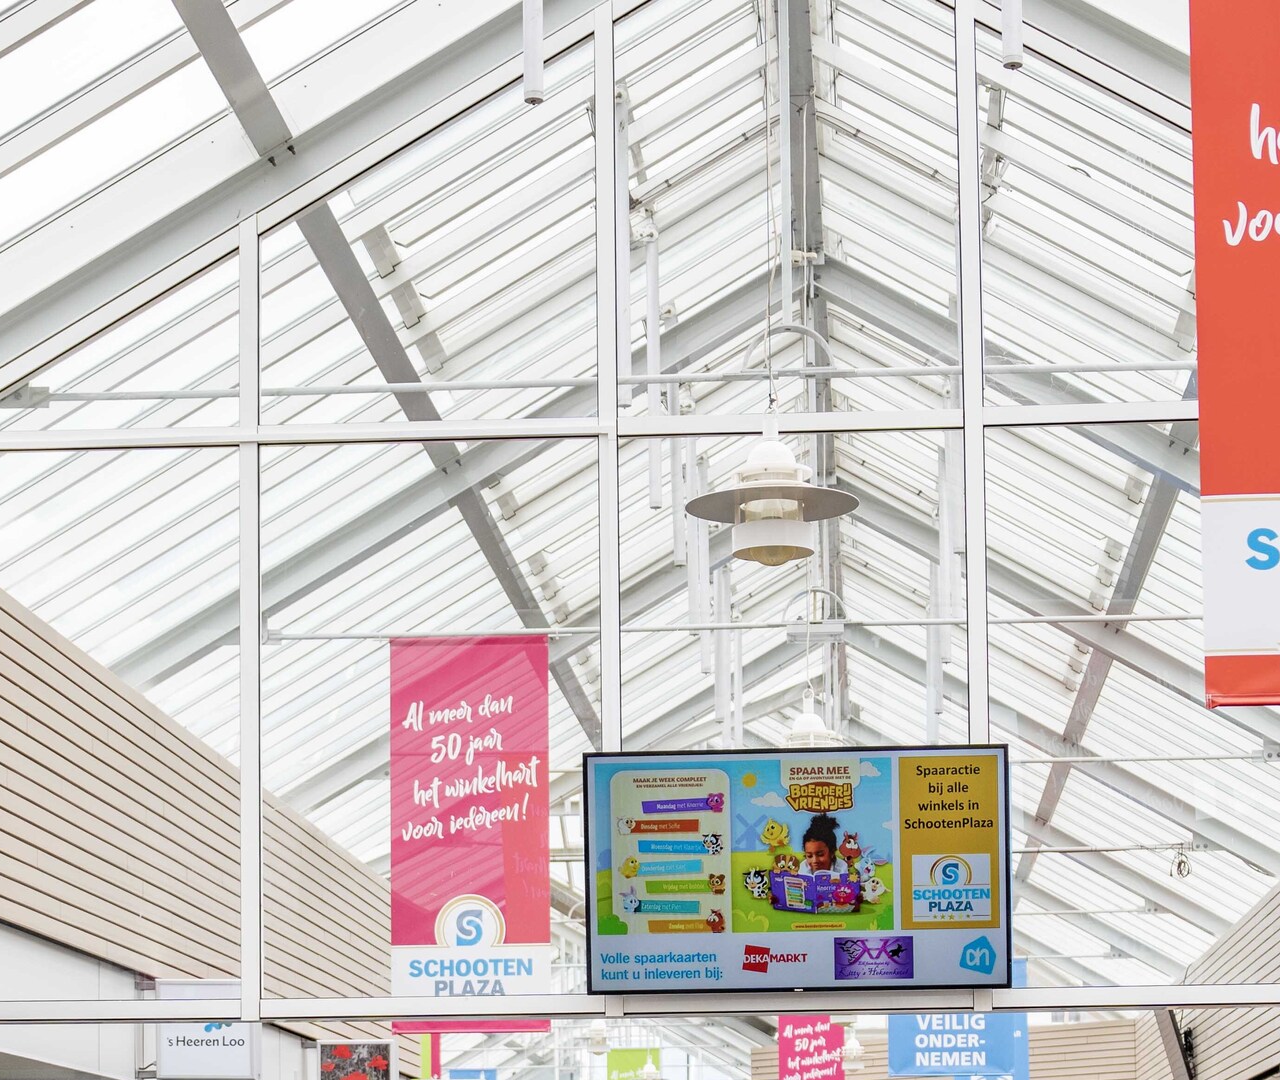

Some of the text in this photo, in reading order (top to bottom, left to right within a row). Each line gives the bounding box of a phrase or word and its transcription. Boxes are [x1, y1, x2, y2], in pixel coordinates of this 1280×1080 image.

[402, 694, 513, 732] Al meer dan
[430, 728, 503, 765] 50 jaar
[789, 766, 849, 775] SPAAR MEE
[916, 764, 980, 778] Spaaractie
[413, 756, 541, 808] het winkelhart
[928, 782, 969, 795] bij alle
[790, 783, 852, 797] BOERDERIJ
[786, 795, 852, 811] VRIENDJES
[918, 799, 979, 811] winkels in
[402, 793, 529, 841] voor iedereen!
[904, 817, 993, 829] SchootenPlaza
[913, 888, 990, 900] SCHOOTEN
[928, 901, 973, 912] PLAZA
[601, 952, 716, 967] Volle spaarkaarten
[408, 958, 533, 978] SCHOOTEN
[601, 968, 723, 982] kunt u inleveren bij:
[434, 979, 505, 997] PLAZA
[916, 1014, 985, 1030] VEILIG
[176, 1037, 245, 1047] Heeren Loo
[794, 1038, 808, 1052] 50
[915, 1033, 985, 1048] ONDER-
[915, 1051, 986, 1067] NEMEN
